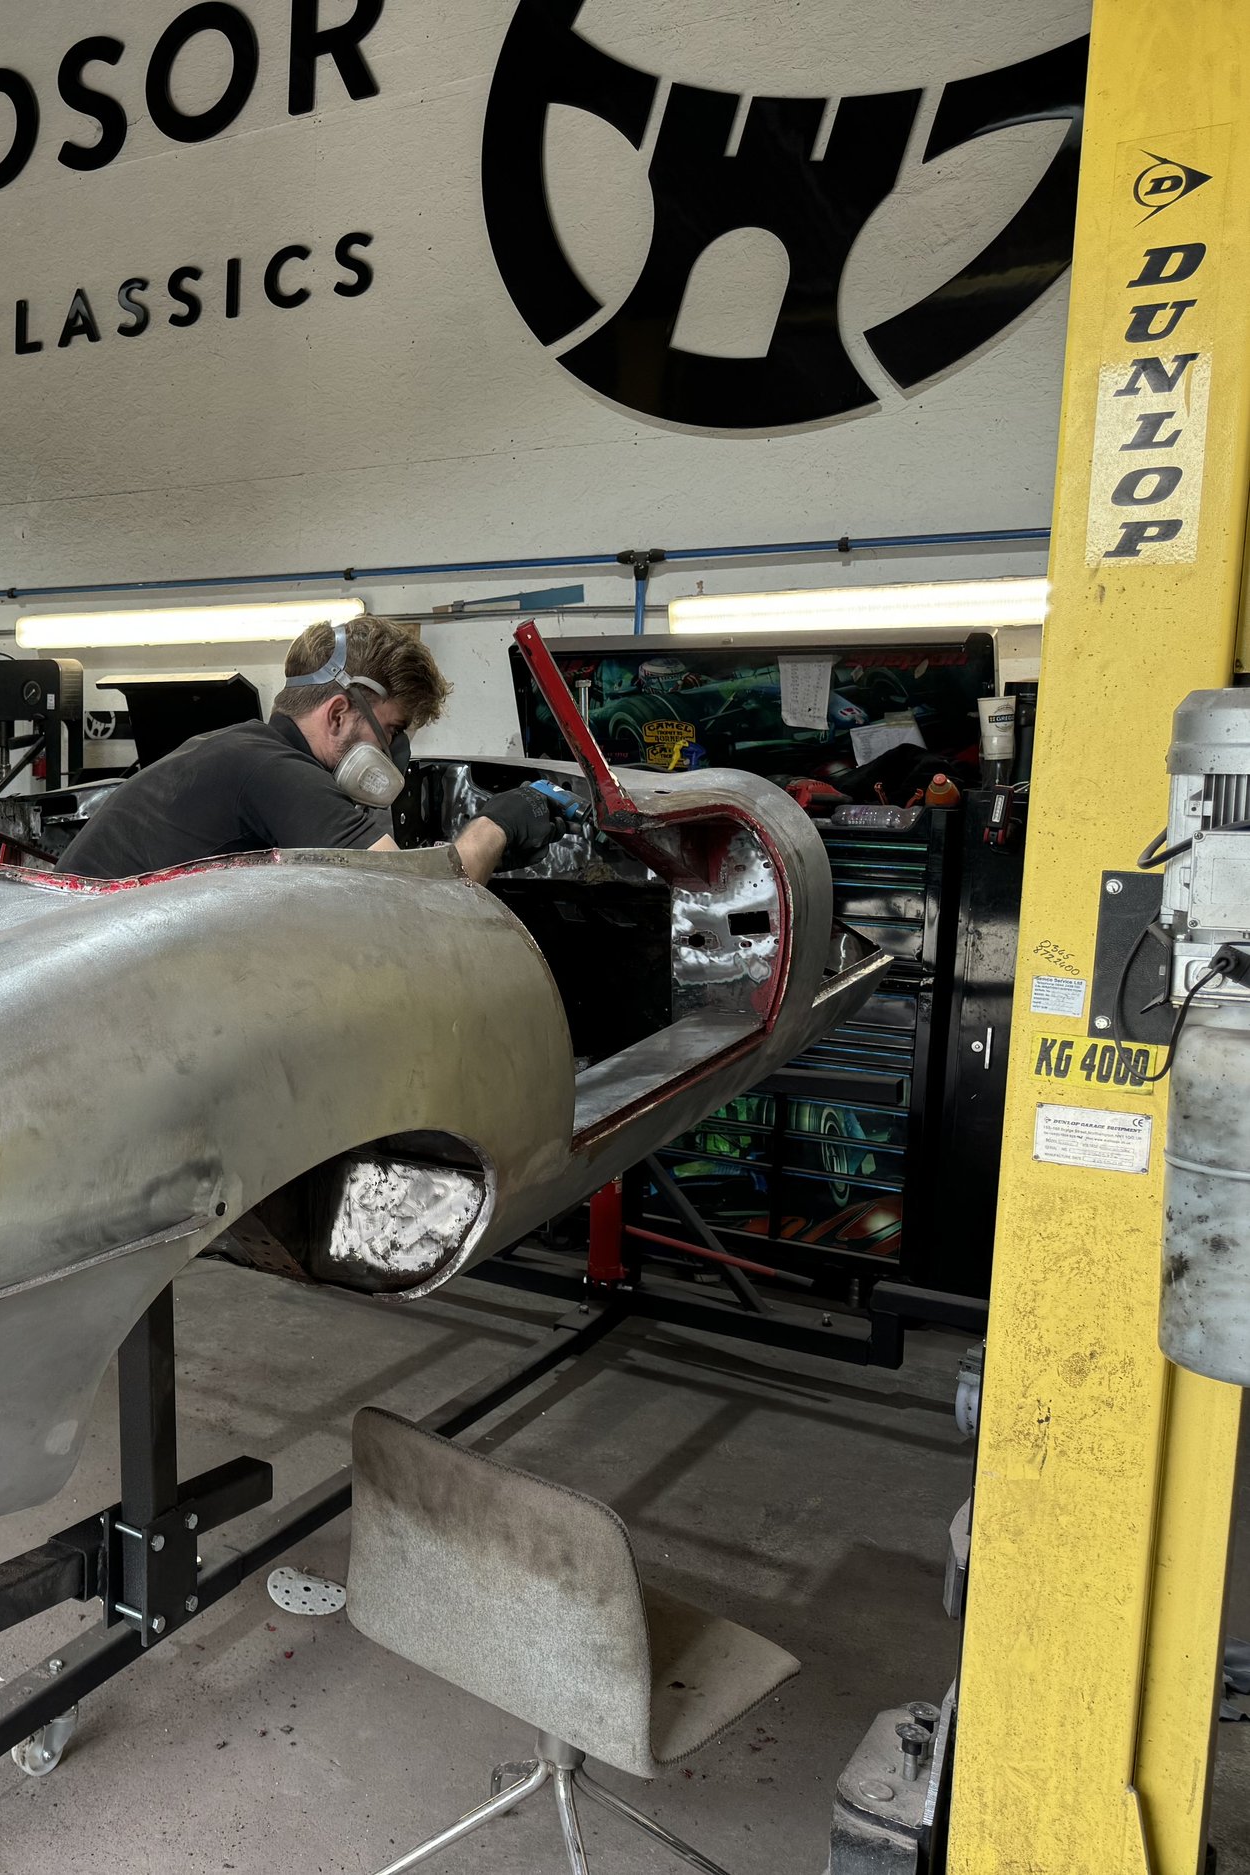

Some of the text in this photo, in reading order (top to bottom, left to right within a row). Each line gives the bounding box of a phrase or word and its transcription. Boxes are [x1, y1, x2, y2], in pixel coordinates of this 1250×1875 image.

[1102, 242, 1207, 559] DUNLOP
[647, 722, 691, 732] CAMEL
[1035, 1037, 1150, 1088] KG 4000
[1053, 1119, 1081, 1127] DUNLOP
